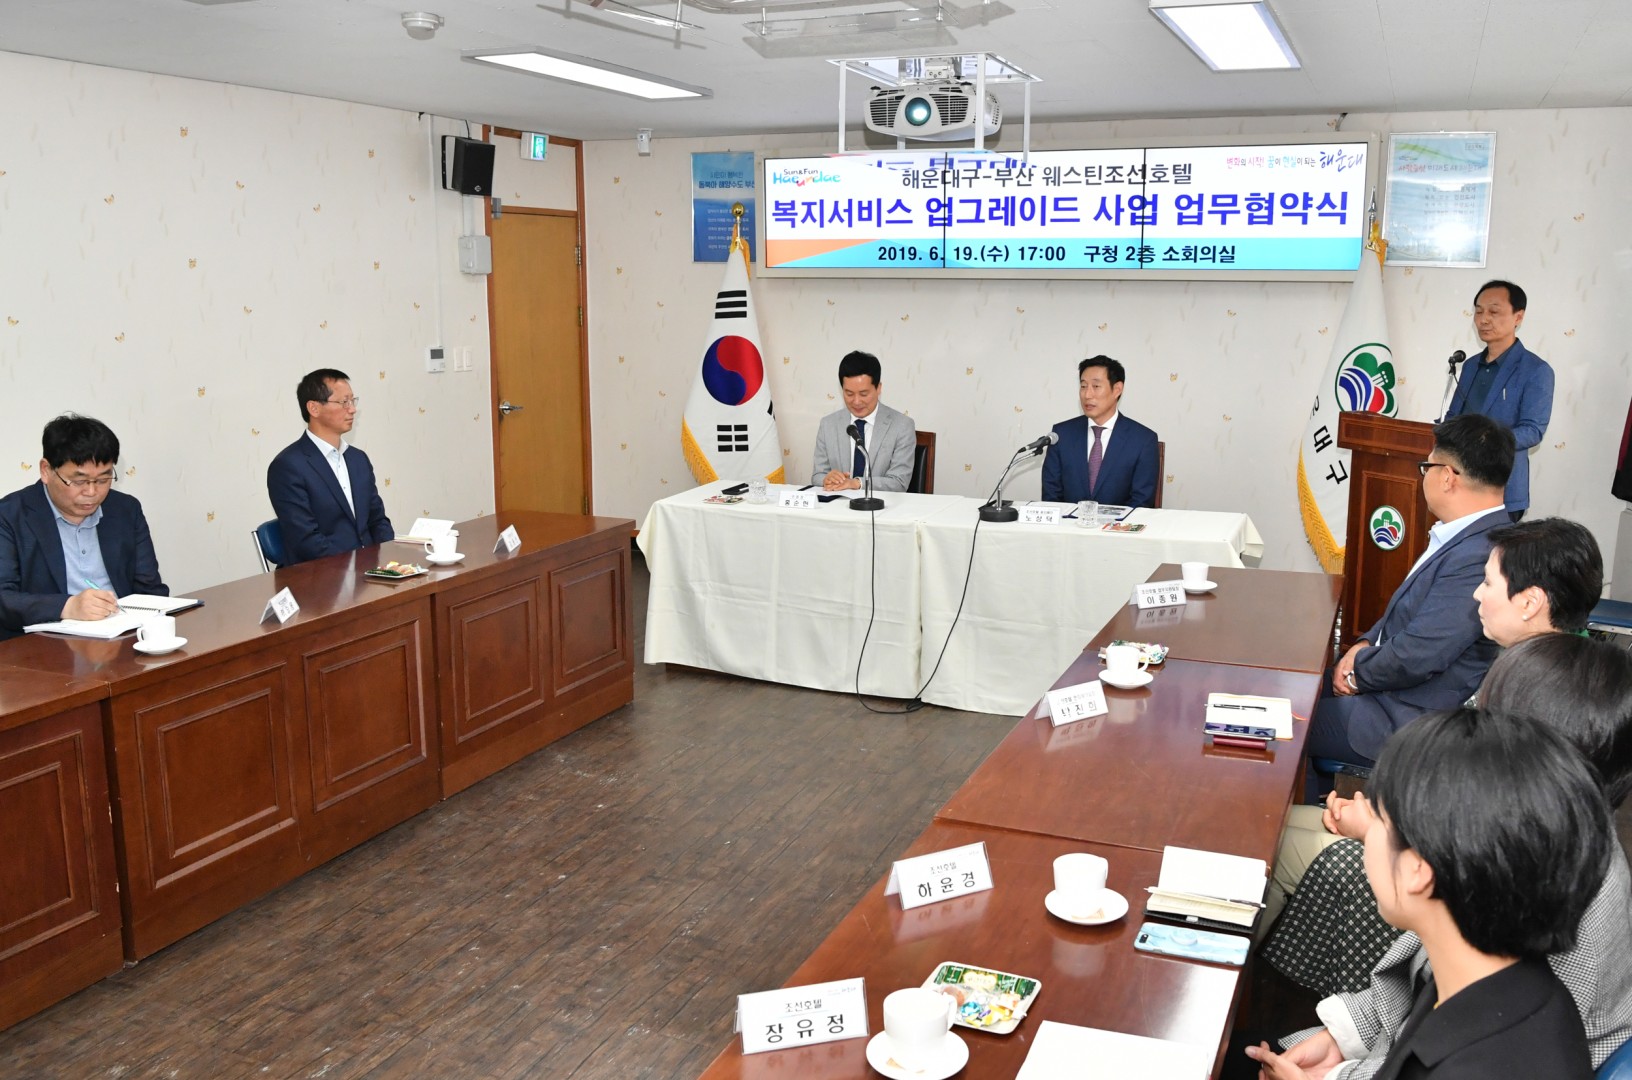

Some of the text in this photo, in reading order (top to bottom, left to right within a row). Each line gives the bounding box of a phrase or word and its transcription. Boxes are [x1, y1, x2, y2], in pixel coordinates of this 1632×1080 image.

[1319, 149, 1364, 173] 해운대
[902, 167, 1035, 189] 해운대구-부산
[1042, 163, 1192, 187] 웨스틴조선호텔
[771, 192, 1348, 229] 복지서비스 업그레이드 사업 업무협약식
[878, 245, 1066, 262] 2019. 6. 19.(수) 17:00
[1084, 245, 1236, 263] 구청 2층 소회의실
[917, 871, 976, 898] 하윤경
[785, 999, 822, 1013] 조선호텔
[765, 1014, 845, 1044] 장유정
